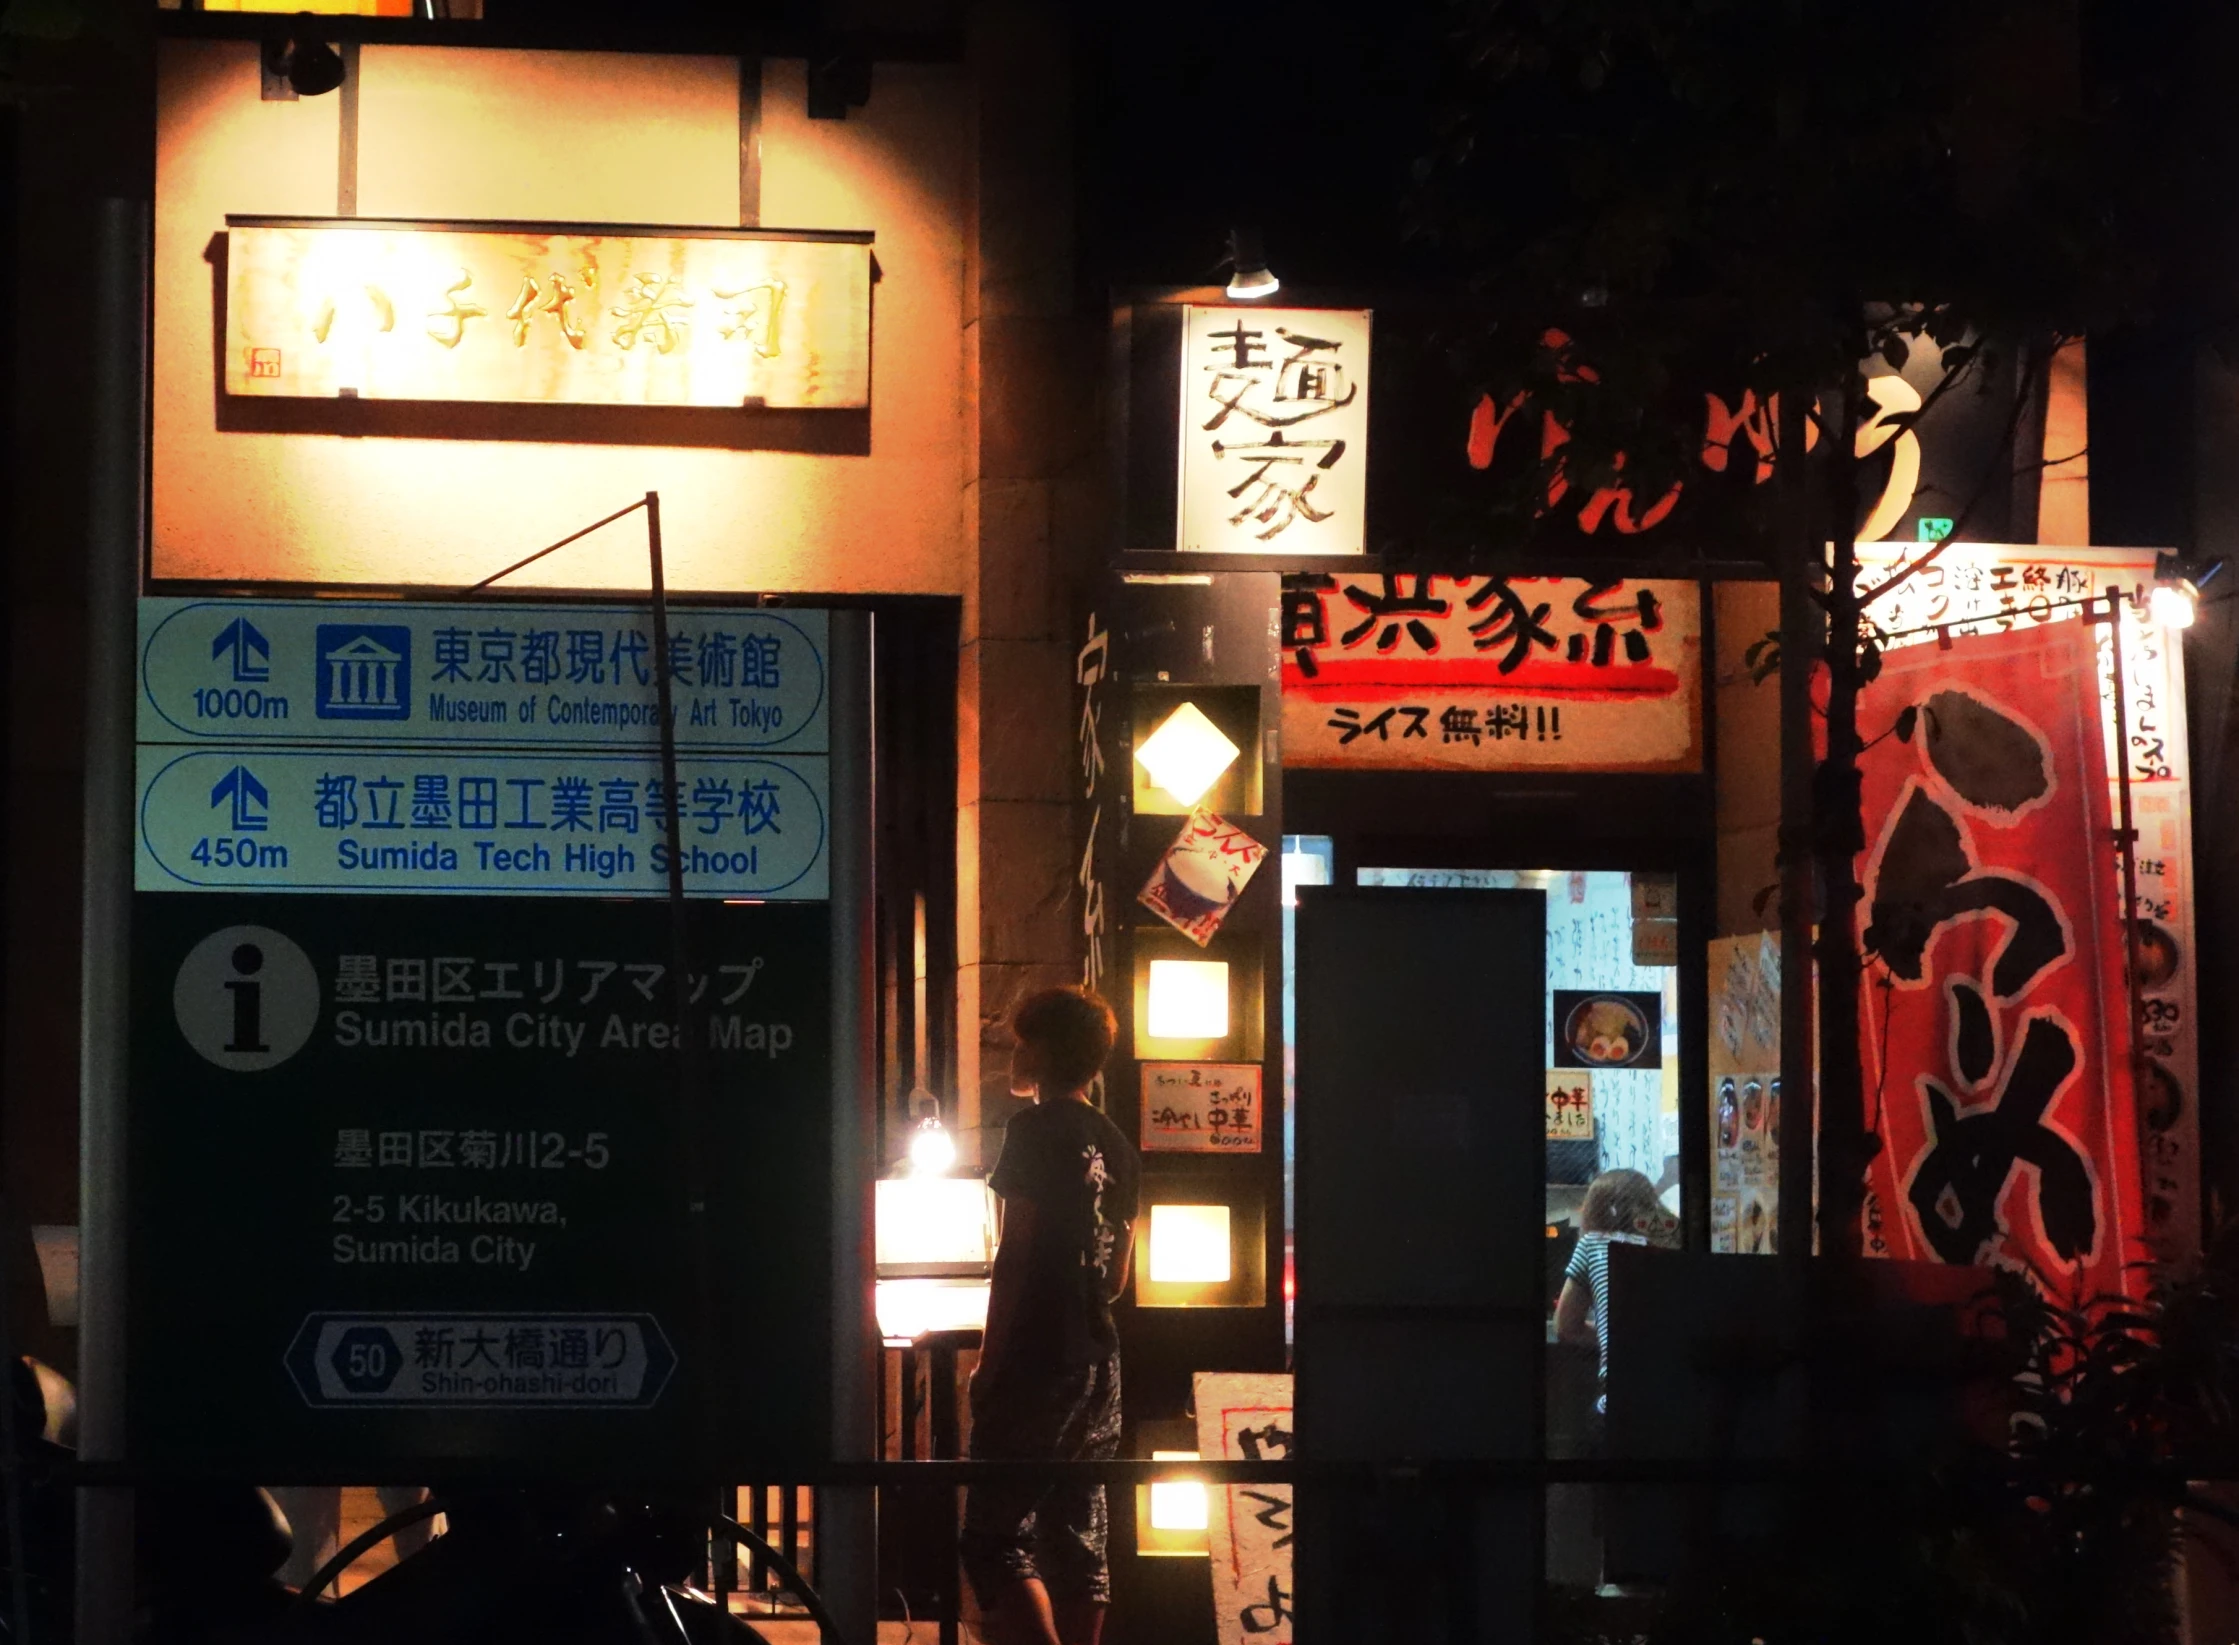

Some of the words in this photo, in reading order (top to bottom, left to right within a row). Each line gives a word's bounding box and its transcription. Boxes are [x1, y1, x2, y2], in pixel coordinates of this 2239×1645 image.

[1202, 318, 1357, 542] 麺家
[432, 626, 781, 689] 東京都現代美術館
[193, 690, 288, 720] 1000m
[429, 693, 506, 724] Museum
[519, 694, 536, 724] of
[548, 694, 678, 731] Contemporay
[691, 698, 717, 727] Art
[729, 698, 783, 734] Tokyo
[315, 773, 781, 836] 都立墨田工業高等学校
[190, 839, 288, 868] 450m
[338, 840, 457, 872] Sumida
[474, 842, 549, 872] Tech
[565, 842, 634, 878] High
[651, 843, 757, 874] School
[335, 954, 765, 1006] 墨田区エリアマップ
[1858, 680, 2103, 1285] らーめ
[335, 1012, 490, 1047] Sumida
[505, 1012, 586, 1057] City
[709, 1014, 793, 1060] Map
[1545, 1085, 1588, 1112] 中華
[1545, 1111, 1586, 1127] ました
[333, 1129, 610, 1171] 墨田区菊川2-5
[333, 1196, 385, 1224] 2-5
[399, 1195, 568, 1228] Kikukawa,
[333, 1235, 459, 1264] Sumida
[470, 1235, 536, 1271] City
[348, 1344, 387, 1379] 50
[415, 1327, 628, 1371] 新大橋通り
[421, 1372, 618, 1394] Shin-ohashi-dori
